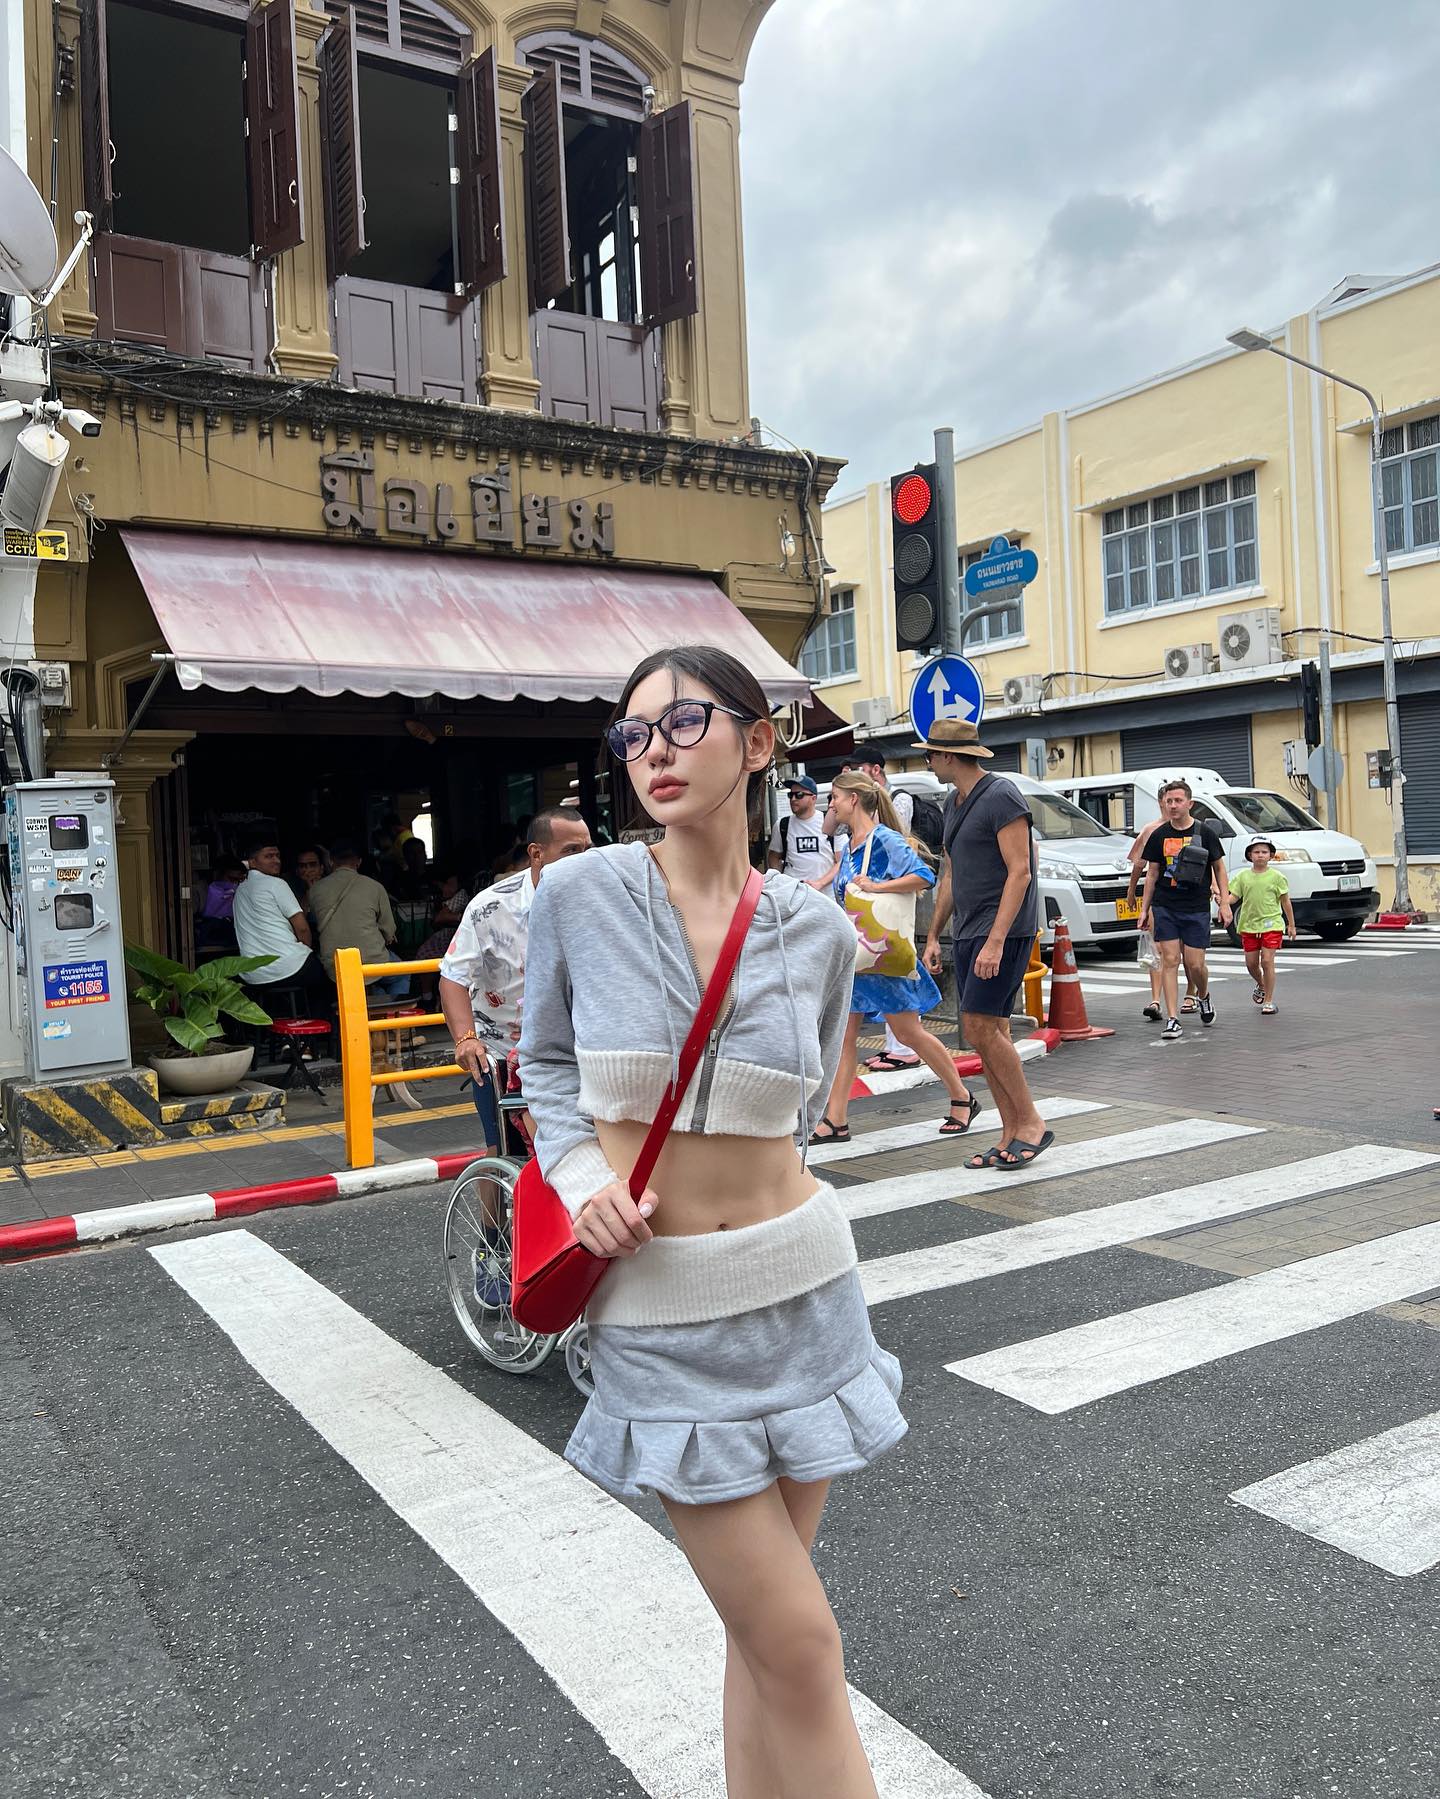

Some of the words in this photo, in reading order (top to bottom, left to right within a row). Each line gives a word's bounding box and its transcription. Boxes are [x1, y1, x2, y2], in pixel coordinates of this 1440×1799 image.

[6, 545, 36, 554] CCTV
[798, 838, 817, 849] HH
[60, 963, 103, 975] ตำรวจท่องเที่ยว
[70, 980, 102, 995] 1155
